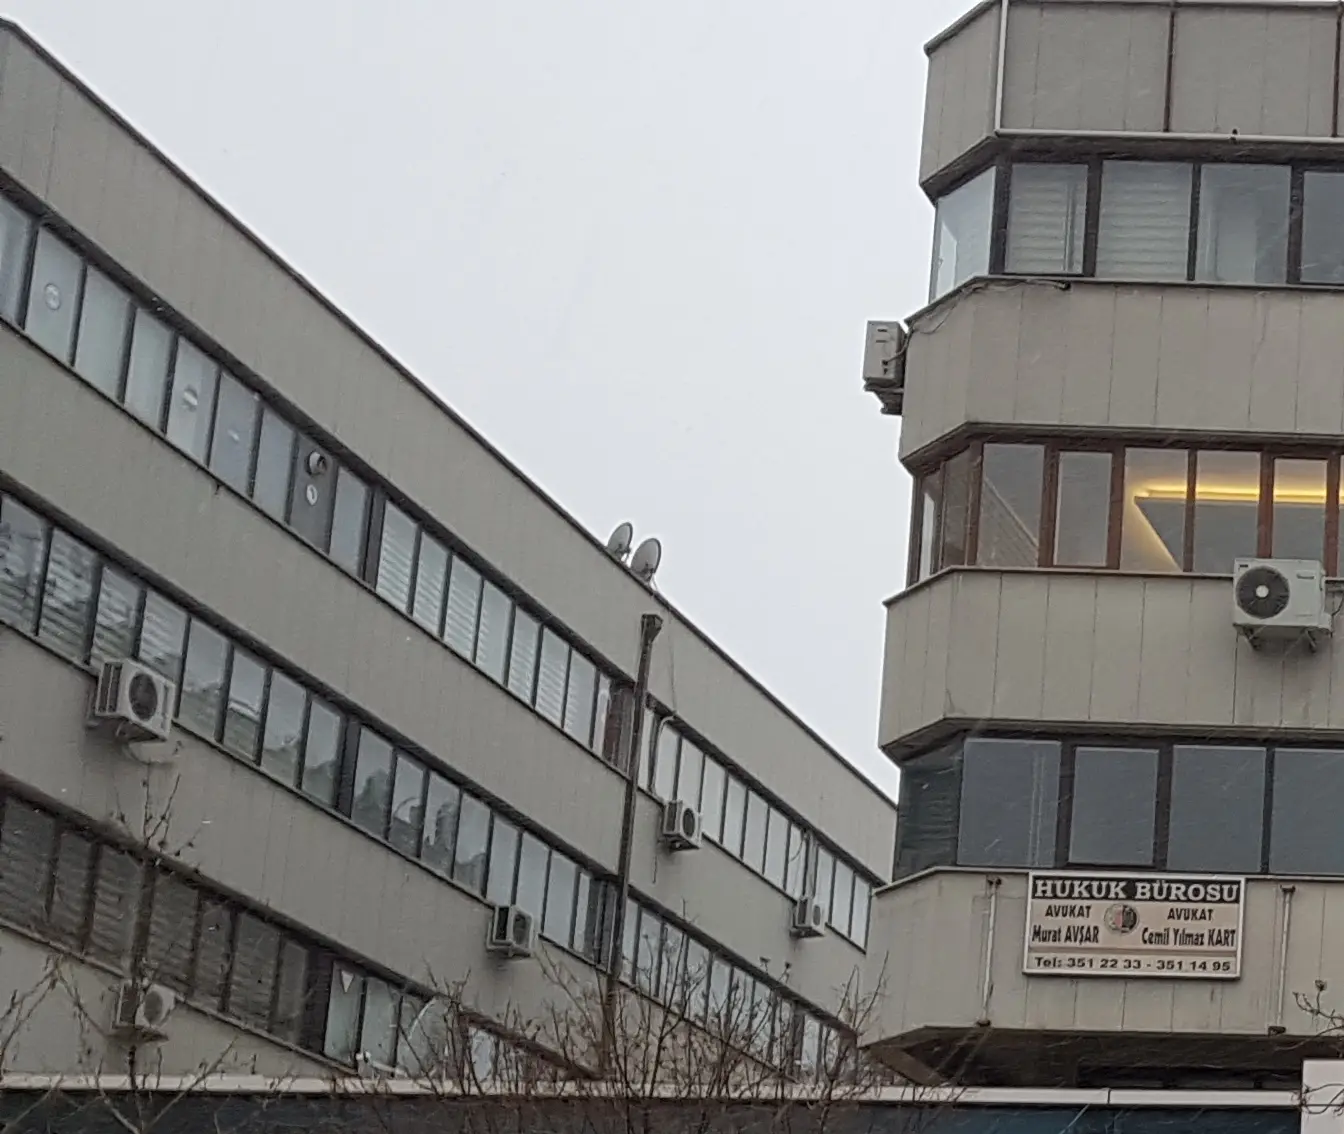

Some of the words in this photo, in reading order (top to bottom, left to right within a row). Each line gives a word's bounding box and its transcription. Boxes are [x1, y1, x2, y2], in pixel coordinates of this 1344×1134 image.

[1035, 880, 1127, 899] HUKUK
[1135, 880, 1239, 901] BÜROSU
[1045, 905, 1091, 918] AVUKAT
[1167, 908, 1213, 921] AVUKAT
[1064, 926, 1099, 945] AVŞAR
[1207, 929, 1236, 947] KART
[1035, 957, 1062, 968] Tel:
[1066, 958, 1094, 968] 351
[1100, 959, 1118, 969] 22
[1156, 960, 1184, 970] 351
